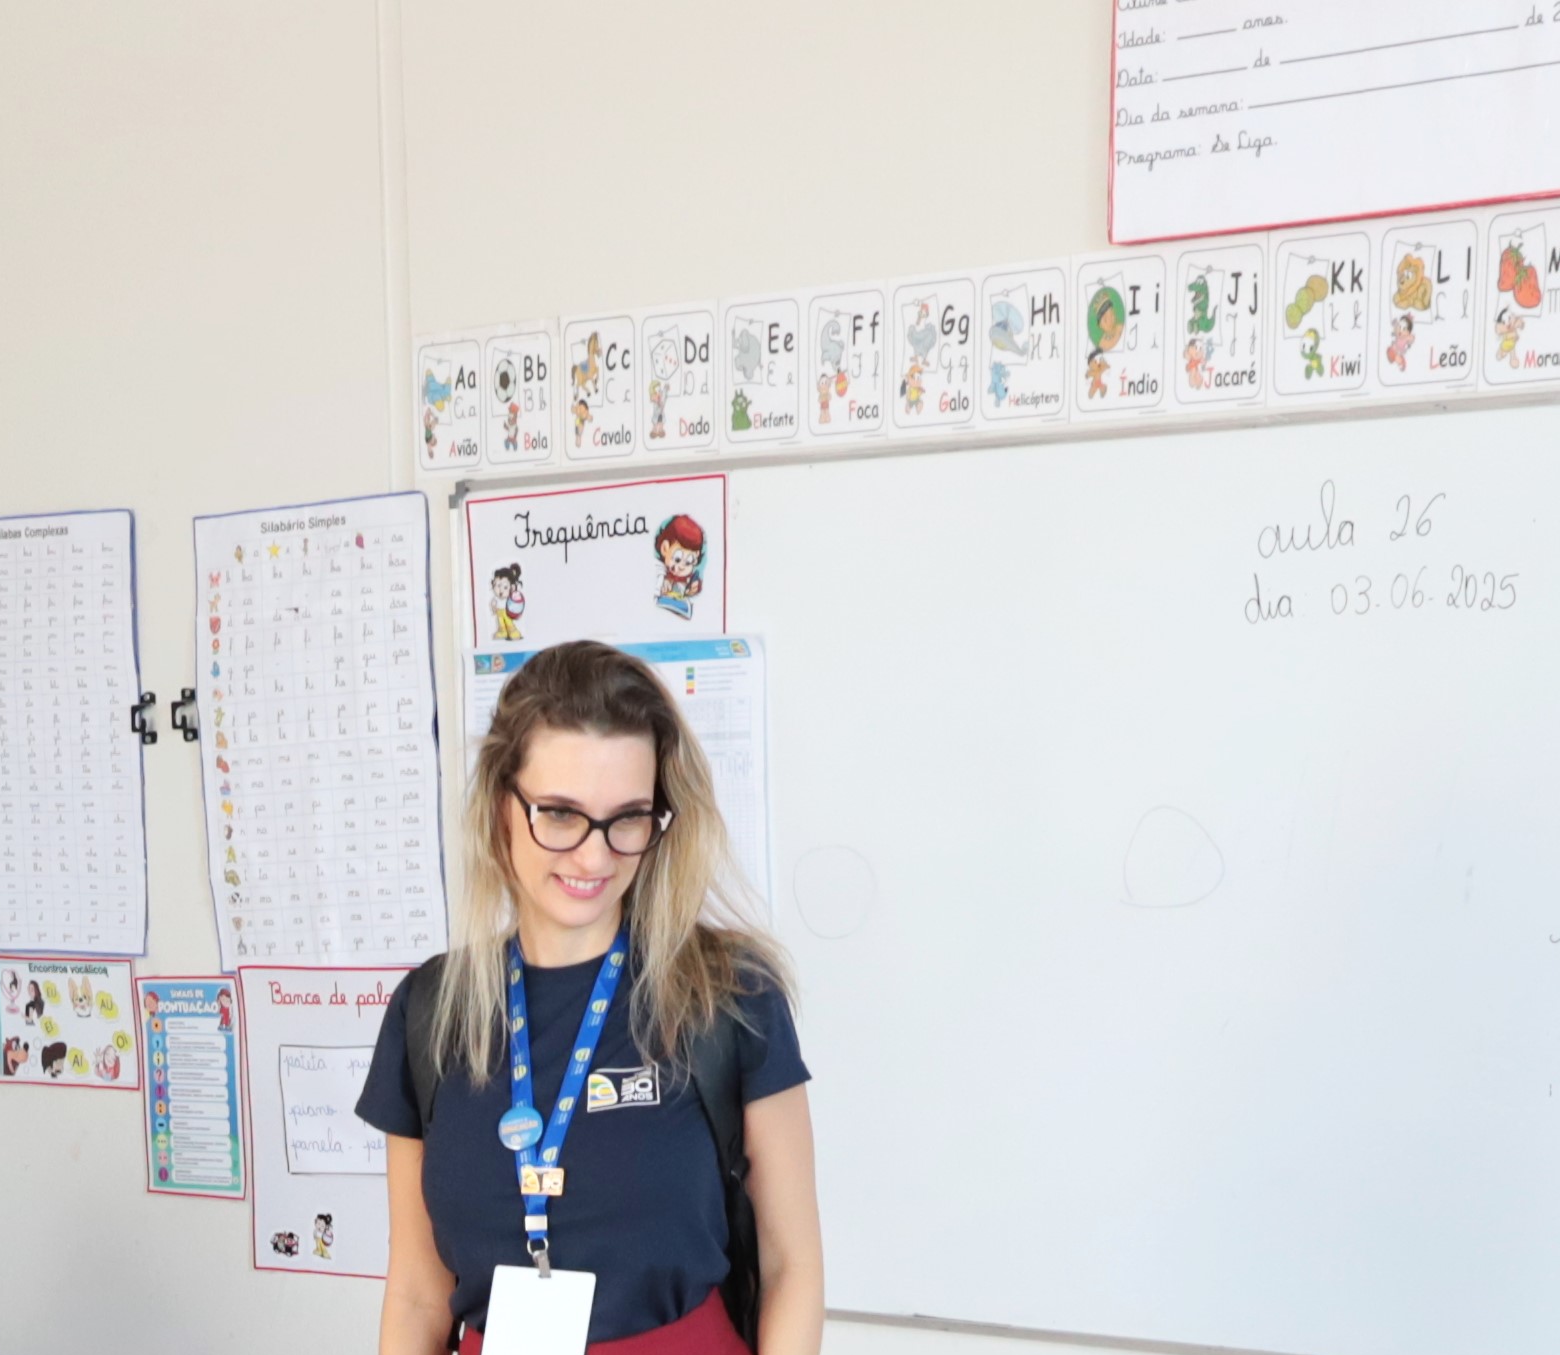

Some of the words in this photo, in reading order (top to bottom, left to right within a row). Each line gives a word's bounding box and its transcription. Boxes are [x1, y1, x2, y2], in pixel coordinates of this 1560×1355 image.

[1116, 27, 1166, 49] Idade:
[1242, 15, 1288, 30] anos.
[1115, 67, 1158, 88] Data:
[1253, 48, 1271, 68] de
[1525, 4, 1544, 27] de
[1115, 108, 1144, 127] Dia
[1150, 103, 1171, 123] da
[1177, 99, 1243, 120] semana:
[1116, 143, 1201, 171] Programa:
[1210, 134, 1230, 154] Se
[1237, 130, 1278, 158] Liga.
[1330, 352, 1362, 378] Kiwi
[1429, 344, 1468, 372] Leão
[1118, 368, 1159, 397] Índio
[1202, 361, 1257, 390] Jacaré
[848, 400, 879, 422] Foca
[938, 390, 970, 412] Galo
[679, 416, 711, 438] Dado
[752, 412, 795, 430] Elefante
[448, 438, 478, 459] Avião
[523, 425, 549, 451] Bola
[592, 425, 632, 448] Cavalo
[260, 519, 306, 534] Silabário
[1256, 478, 1356, 560] aula
[1388, 492, 1448, 542] 26
[513, 509, 650, 565] Frequência
[1243, 571, 1296, 626] dia
[29, 963, 68, 974] Encontros
[269, 981, 322, 1005] Banco
[329, 981, 348, 1005] de
